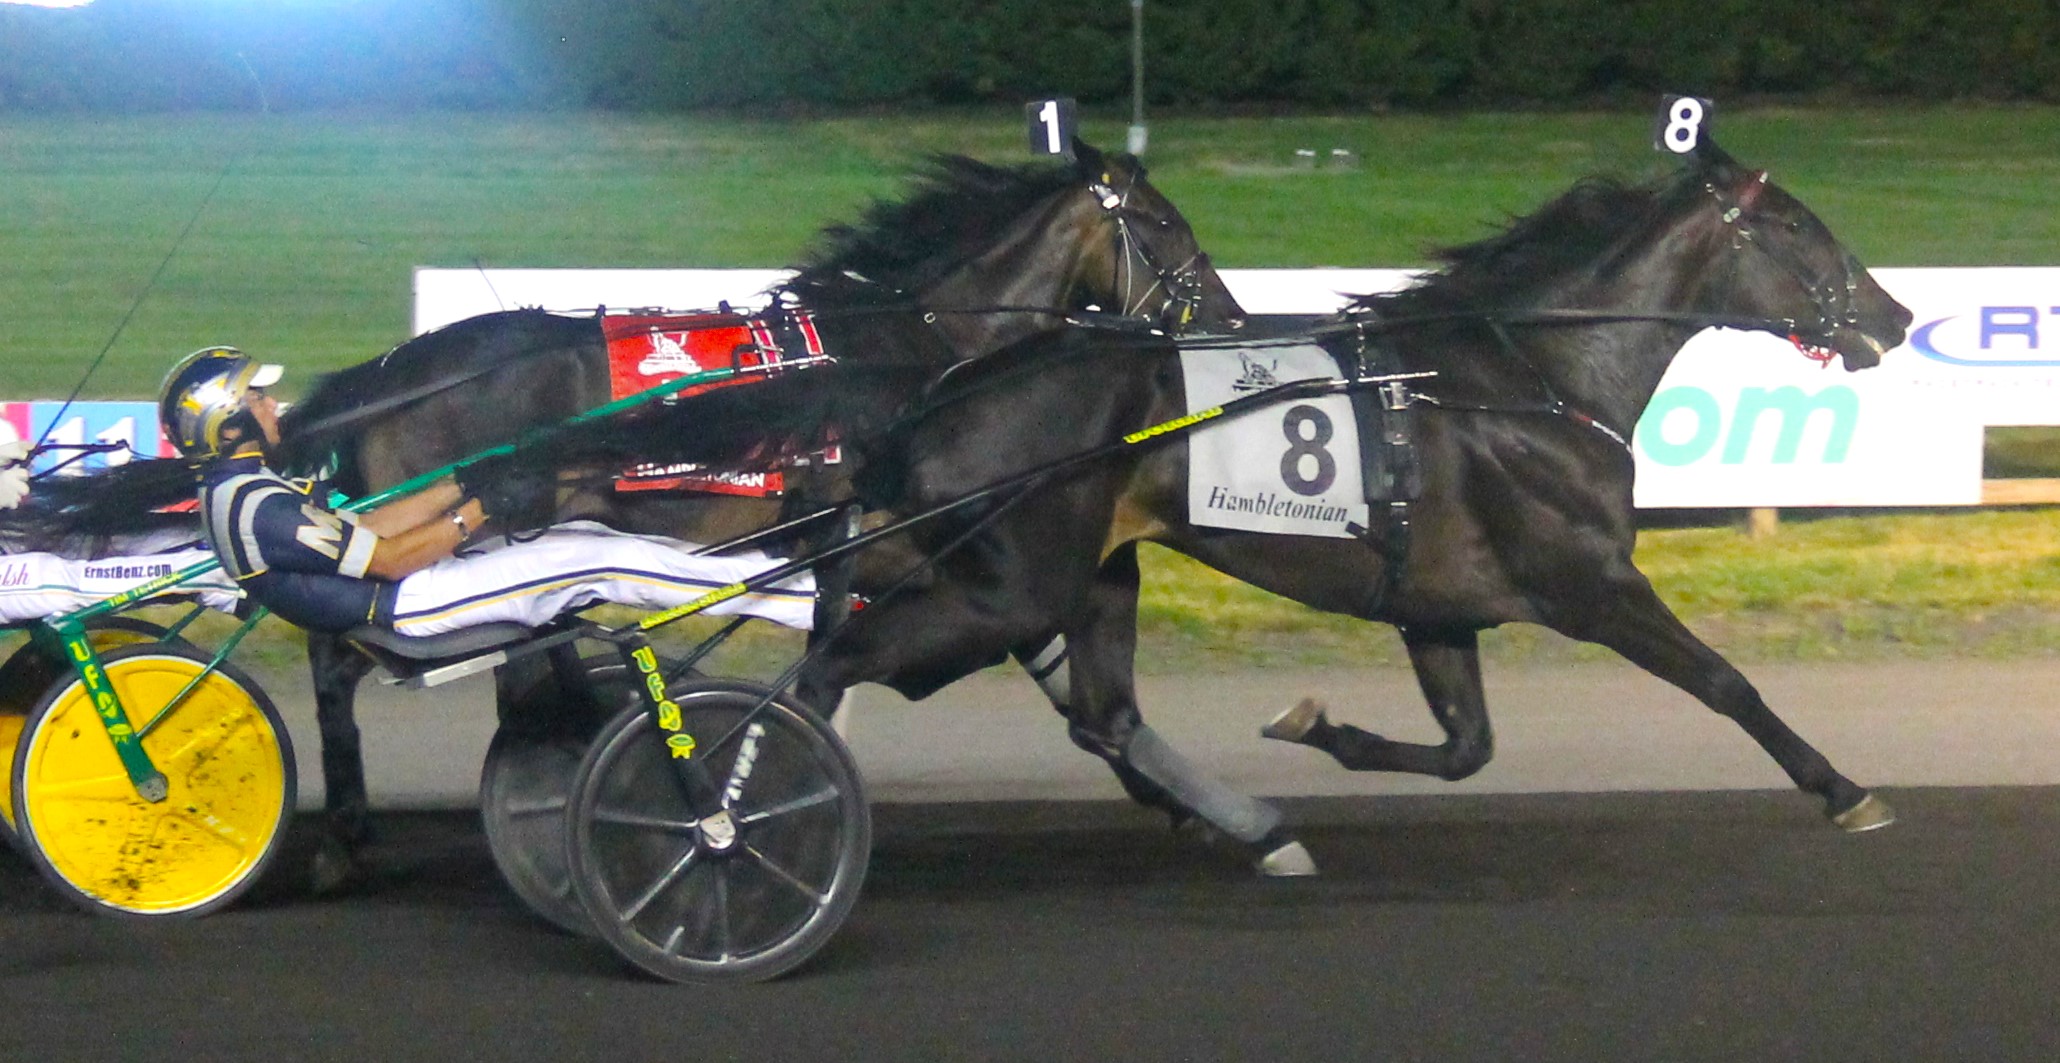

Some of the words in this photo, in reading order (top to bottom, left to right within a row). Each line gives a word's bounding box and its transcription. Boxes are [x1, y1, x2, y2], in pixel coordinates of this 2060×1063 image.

[1038, 100, 1062, 154] 1
[1664, 97, 1703, 153] 8
[1980, 306, 2060, 349] R
[1280, 404, 1336, 496] 8
[1207, 485, 1348, 523] Hambletonian
[295, 503, 343, 560] M
[0, 562, 29, 587] lsh
[84, 563, 172, 579] ErnstBenz.com
